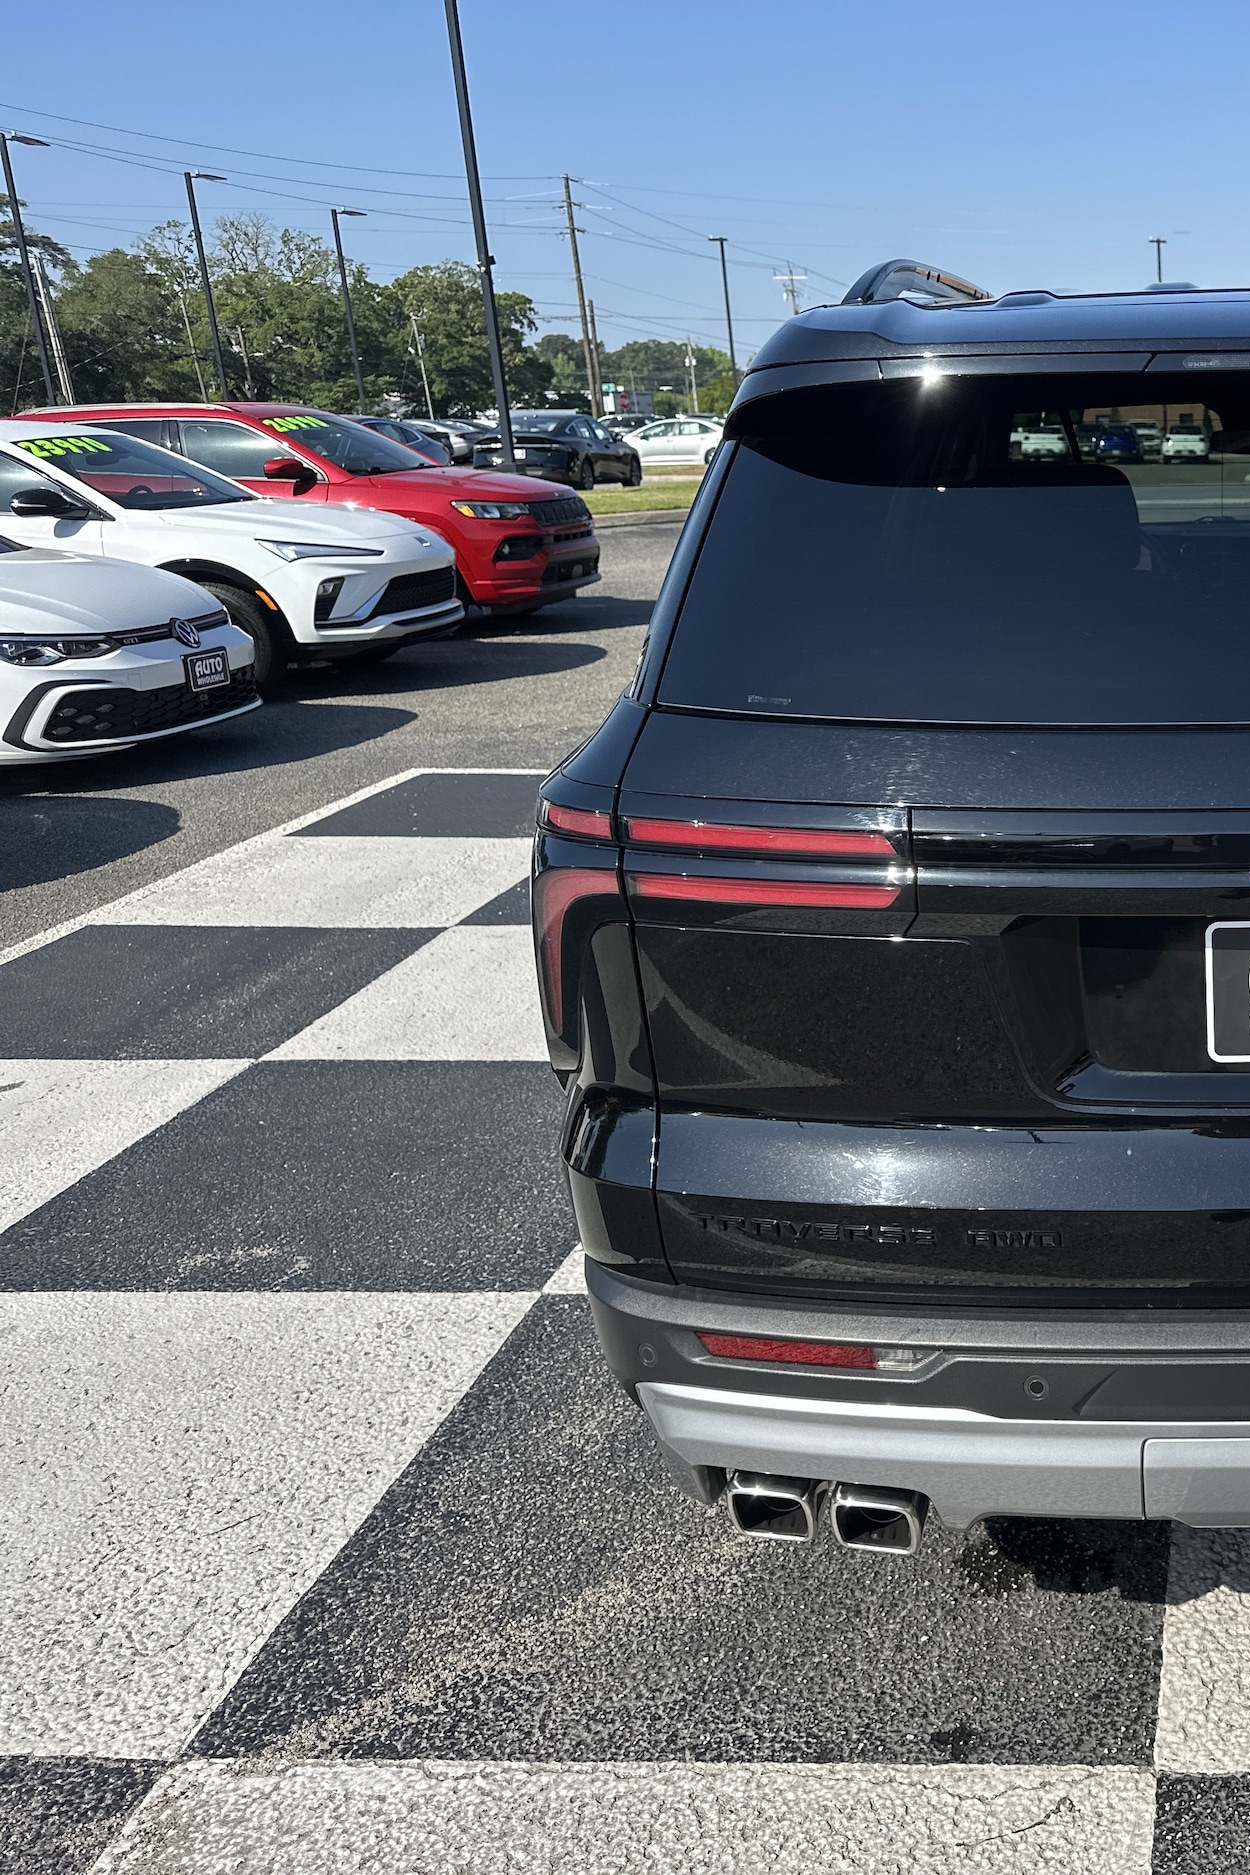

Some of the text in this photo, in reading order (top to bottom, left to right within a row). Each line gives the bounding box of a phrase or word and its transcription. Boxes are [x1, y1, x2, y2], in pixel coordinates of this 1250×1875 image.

[262, 415, 330, 432] 20990
[17, 436, 113, 458] 23990
[195, 656, 223, 678] AUTO
[690, 1213, 1064, 1247] TRAVERSE AWD
